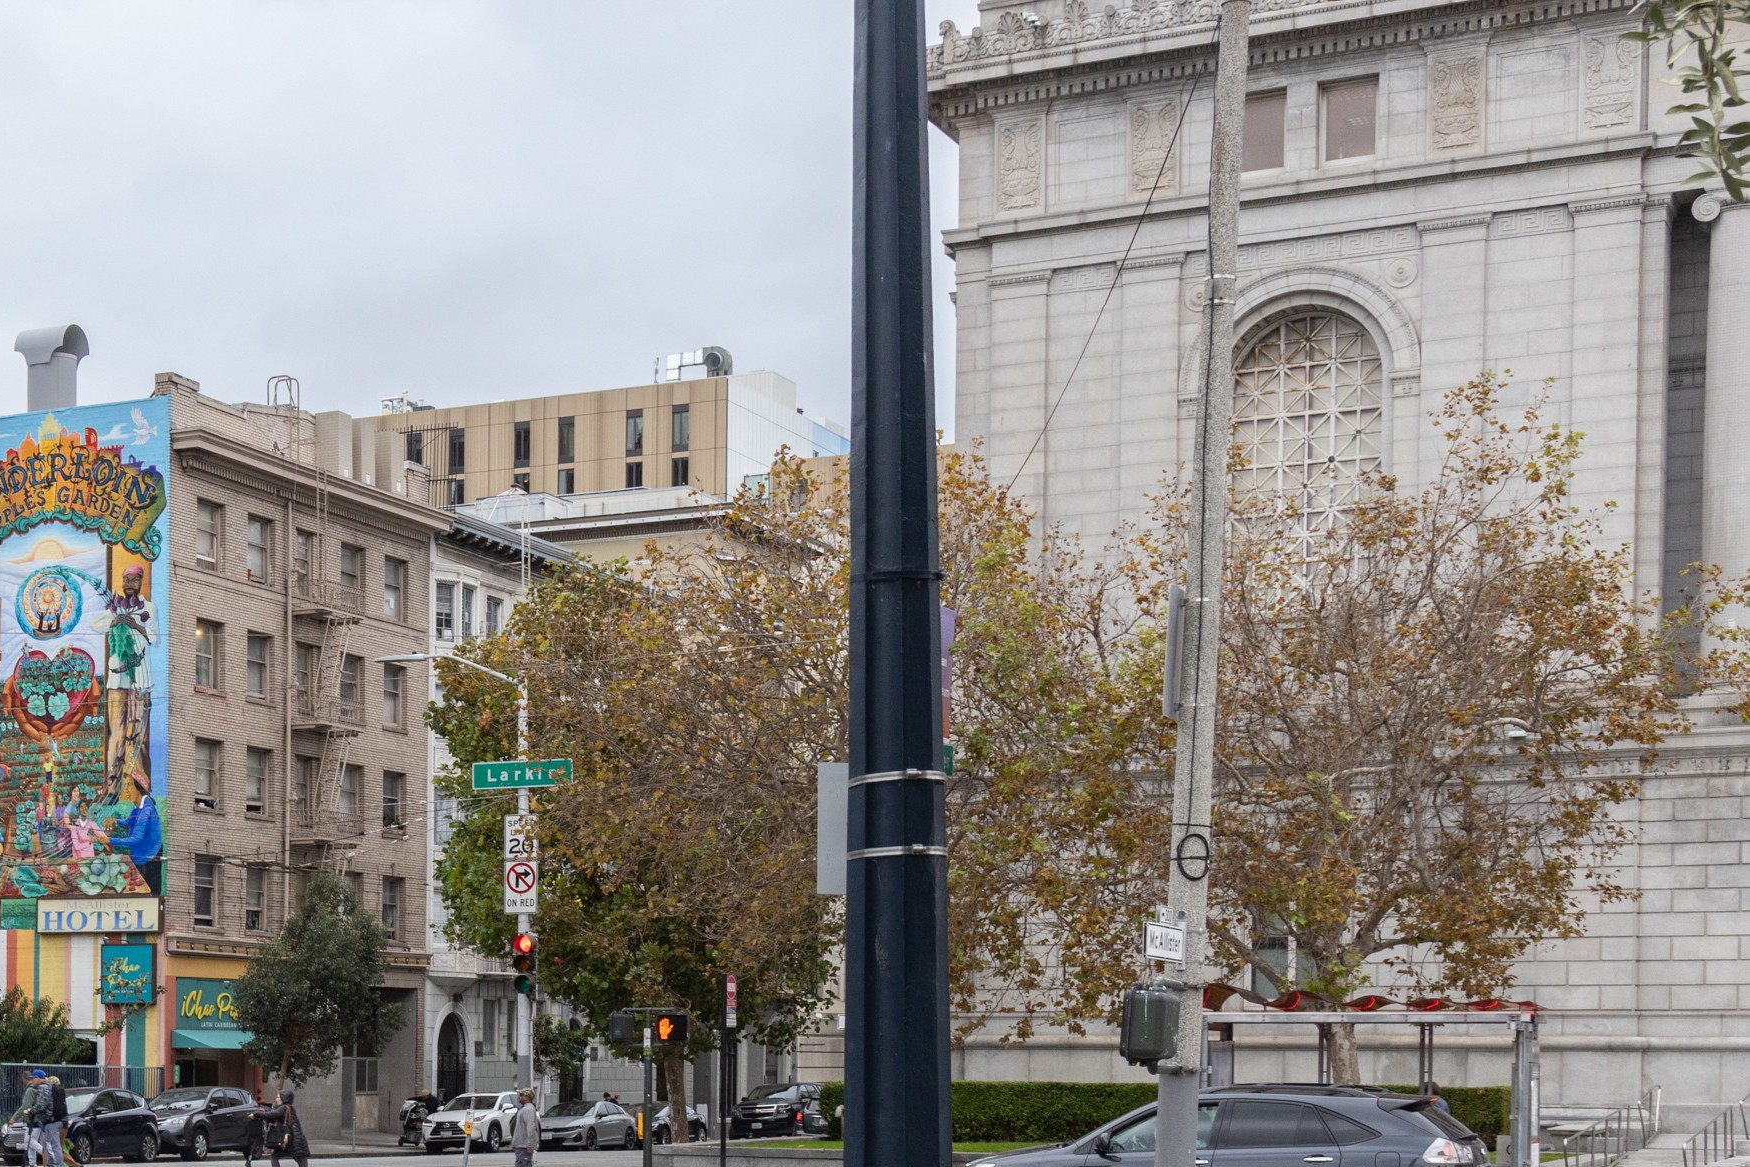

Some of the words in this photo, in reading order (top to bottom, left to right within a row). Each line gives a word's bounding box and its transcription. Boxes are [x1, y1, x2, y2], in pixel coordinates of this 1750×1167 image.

[56, 485, 140, 529] GARDEN
[508, 838, 534, 855] 20
[65, 900, 131, 910] McAllister
[506, 898, 517, 908] ON
[520, 898, 535, 907] RED
[42, 909, 155, 932] HOTEL
[1149, 928, 1181, 953] McAllister
